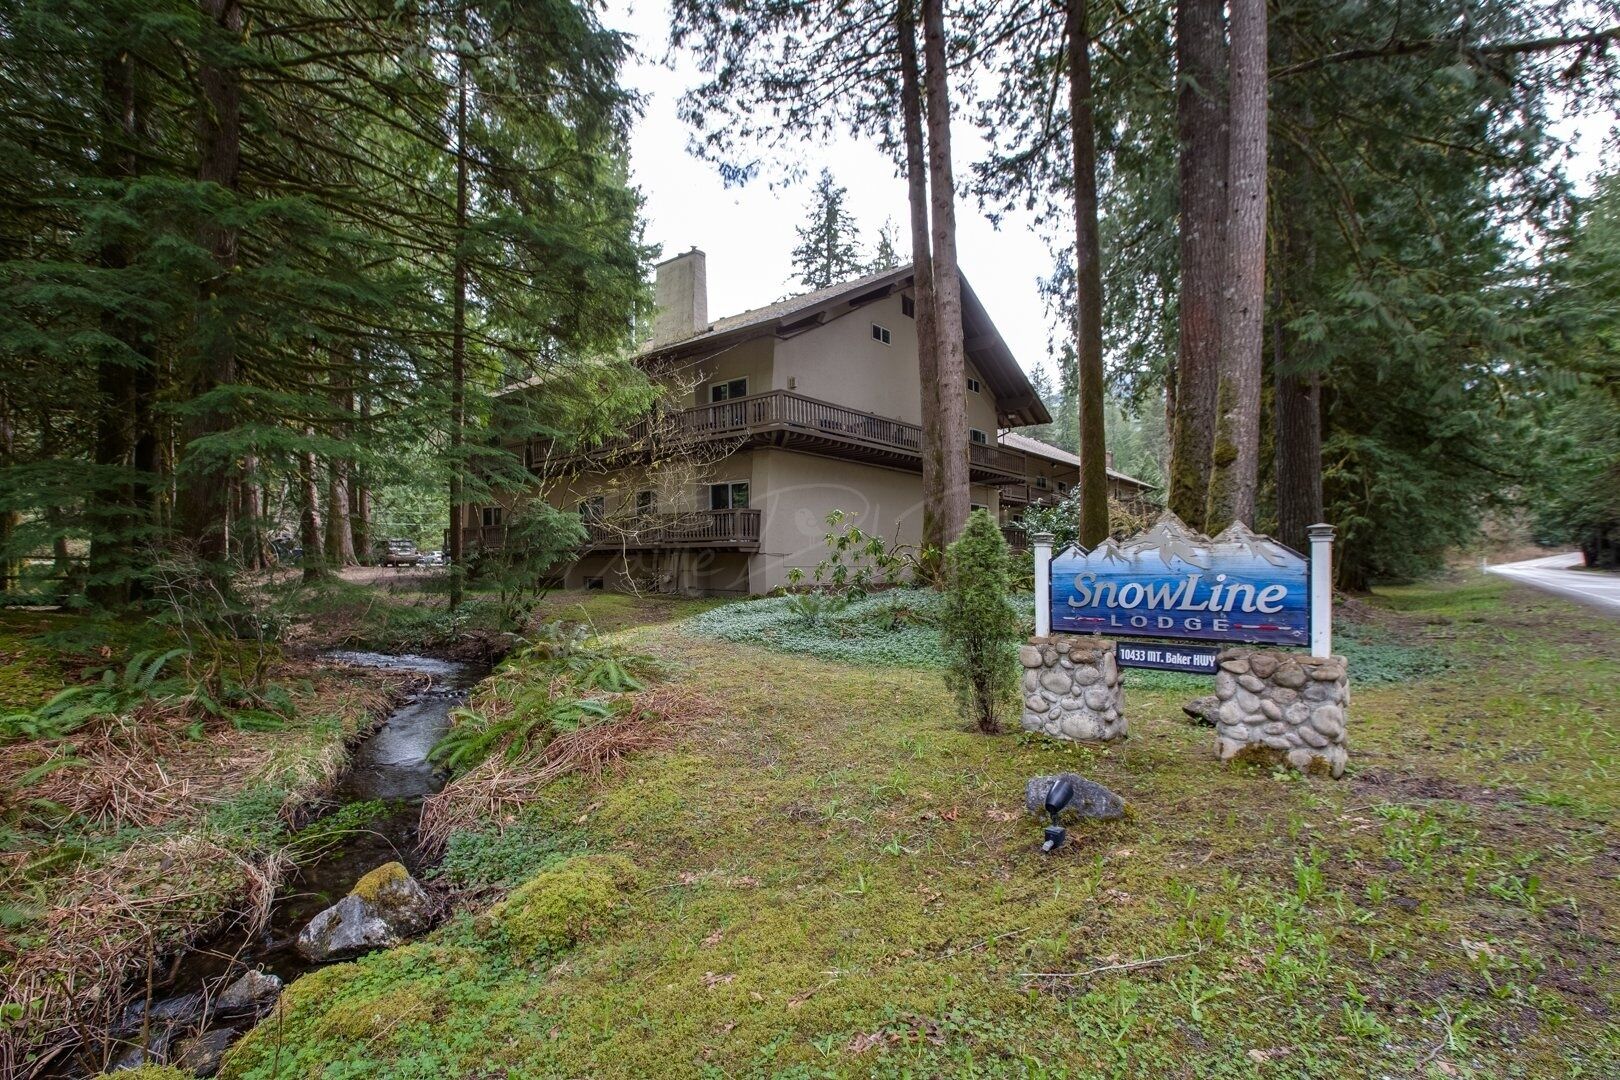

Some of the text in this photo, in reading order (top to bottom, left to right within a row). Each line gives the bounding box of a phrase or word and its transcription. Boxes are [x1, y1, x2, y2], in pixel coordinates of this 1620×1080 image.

[1067, 571, 1288, 615] SnowLine
[1110, 614, 1229, 632] LODGE
[1120, 648, 1216, 667] 10433 MT. Baker HWY
